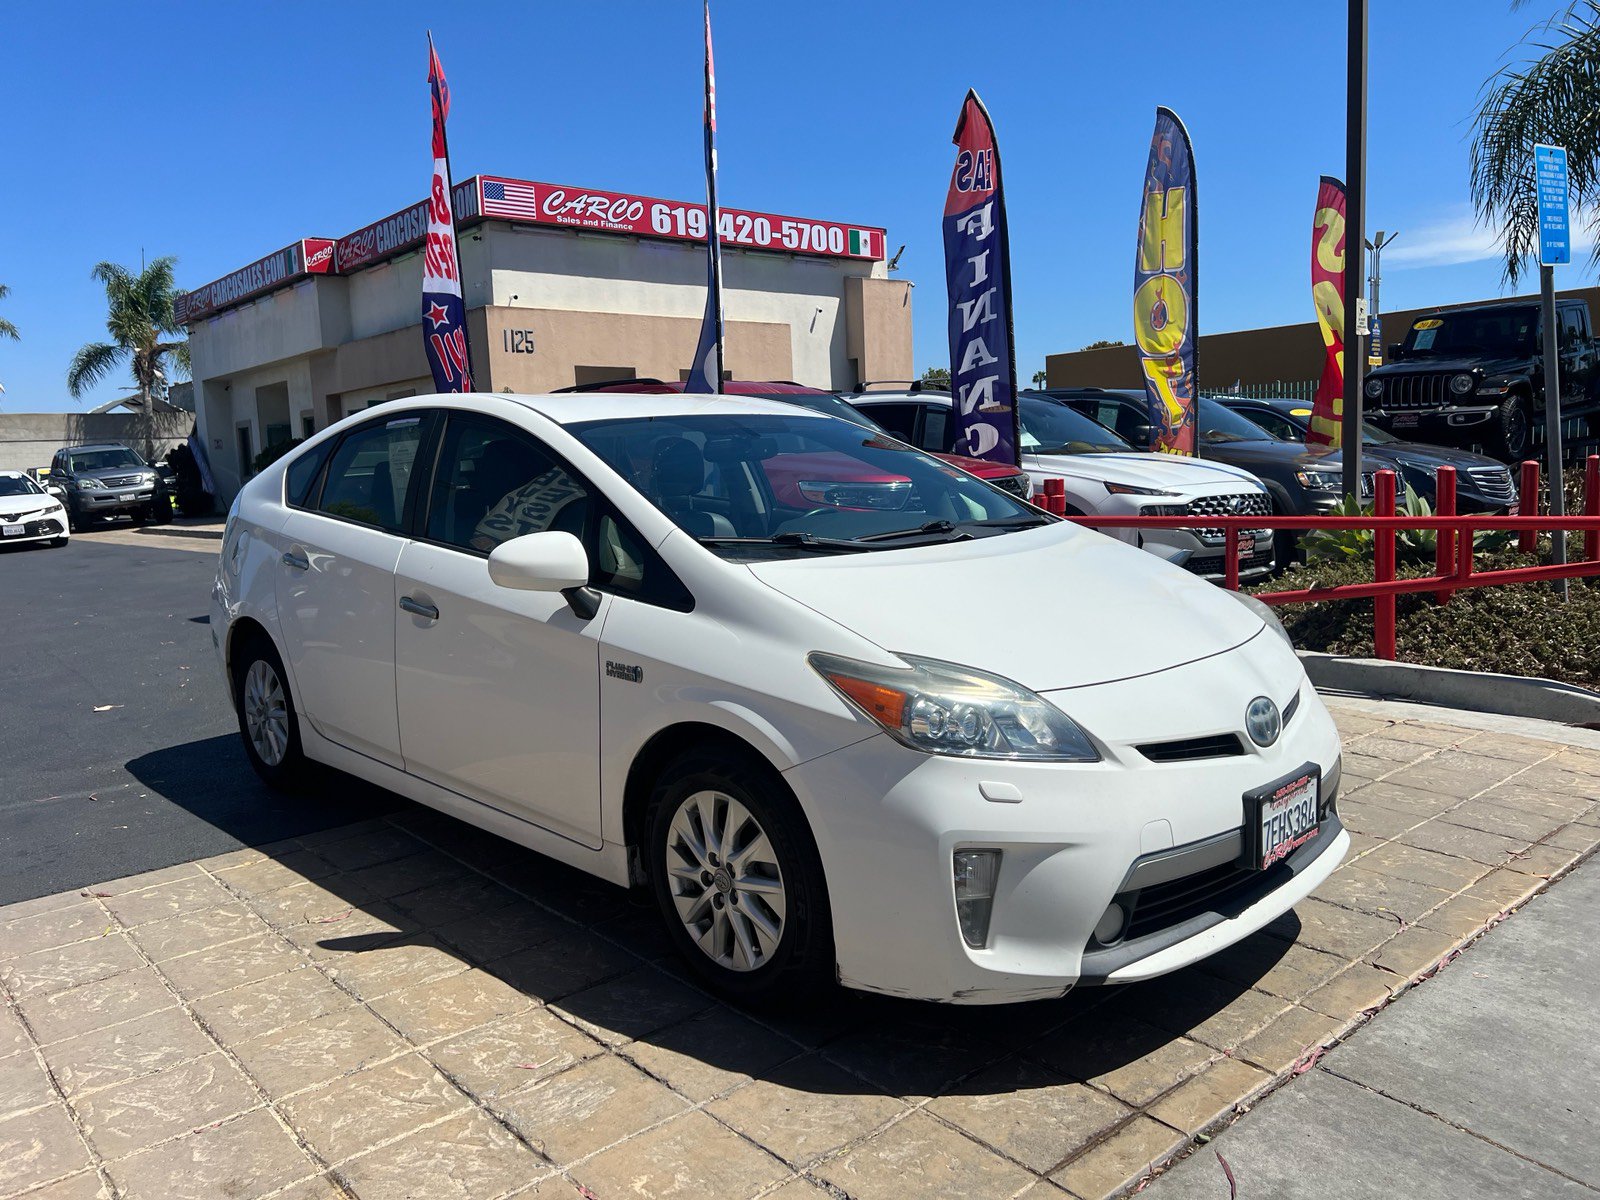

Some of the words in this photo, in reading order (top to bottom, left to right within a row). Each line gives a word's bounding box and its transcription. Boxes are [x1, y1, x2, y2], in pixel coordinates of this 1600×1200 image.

[542, 190, 644, 223] CARCO
[556, 215, 581, 225] Sales
[583, 219, 598, 227] and
[600, 220, 634, 231] Finance
[306, 245, 333, 267] CARCO
[338, 229, 375, 265] CARCO
[210, 252, 286, 307] CARCOSALES.COM
[1134, 186, 1190, 428] HOT
[503, 328, 535, 355] 1125
[1263, 796, 1315, 850] 7EHS384
